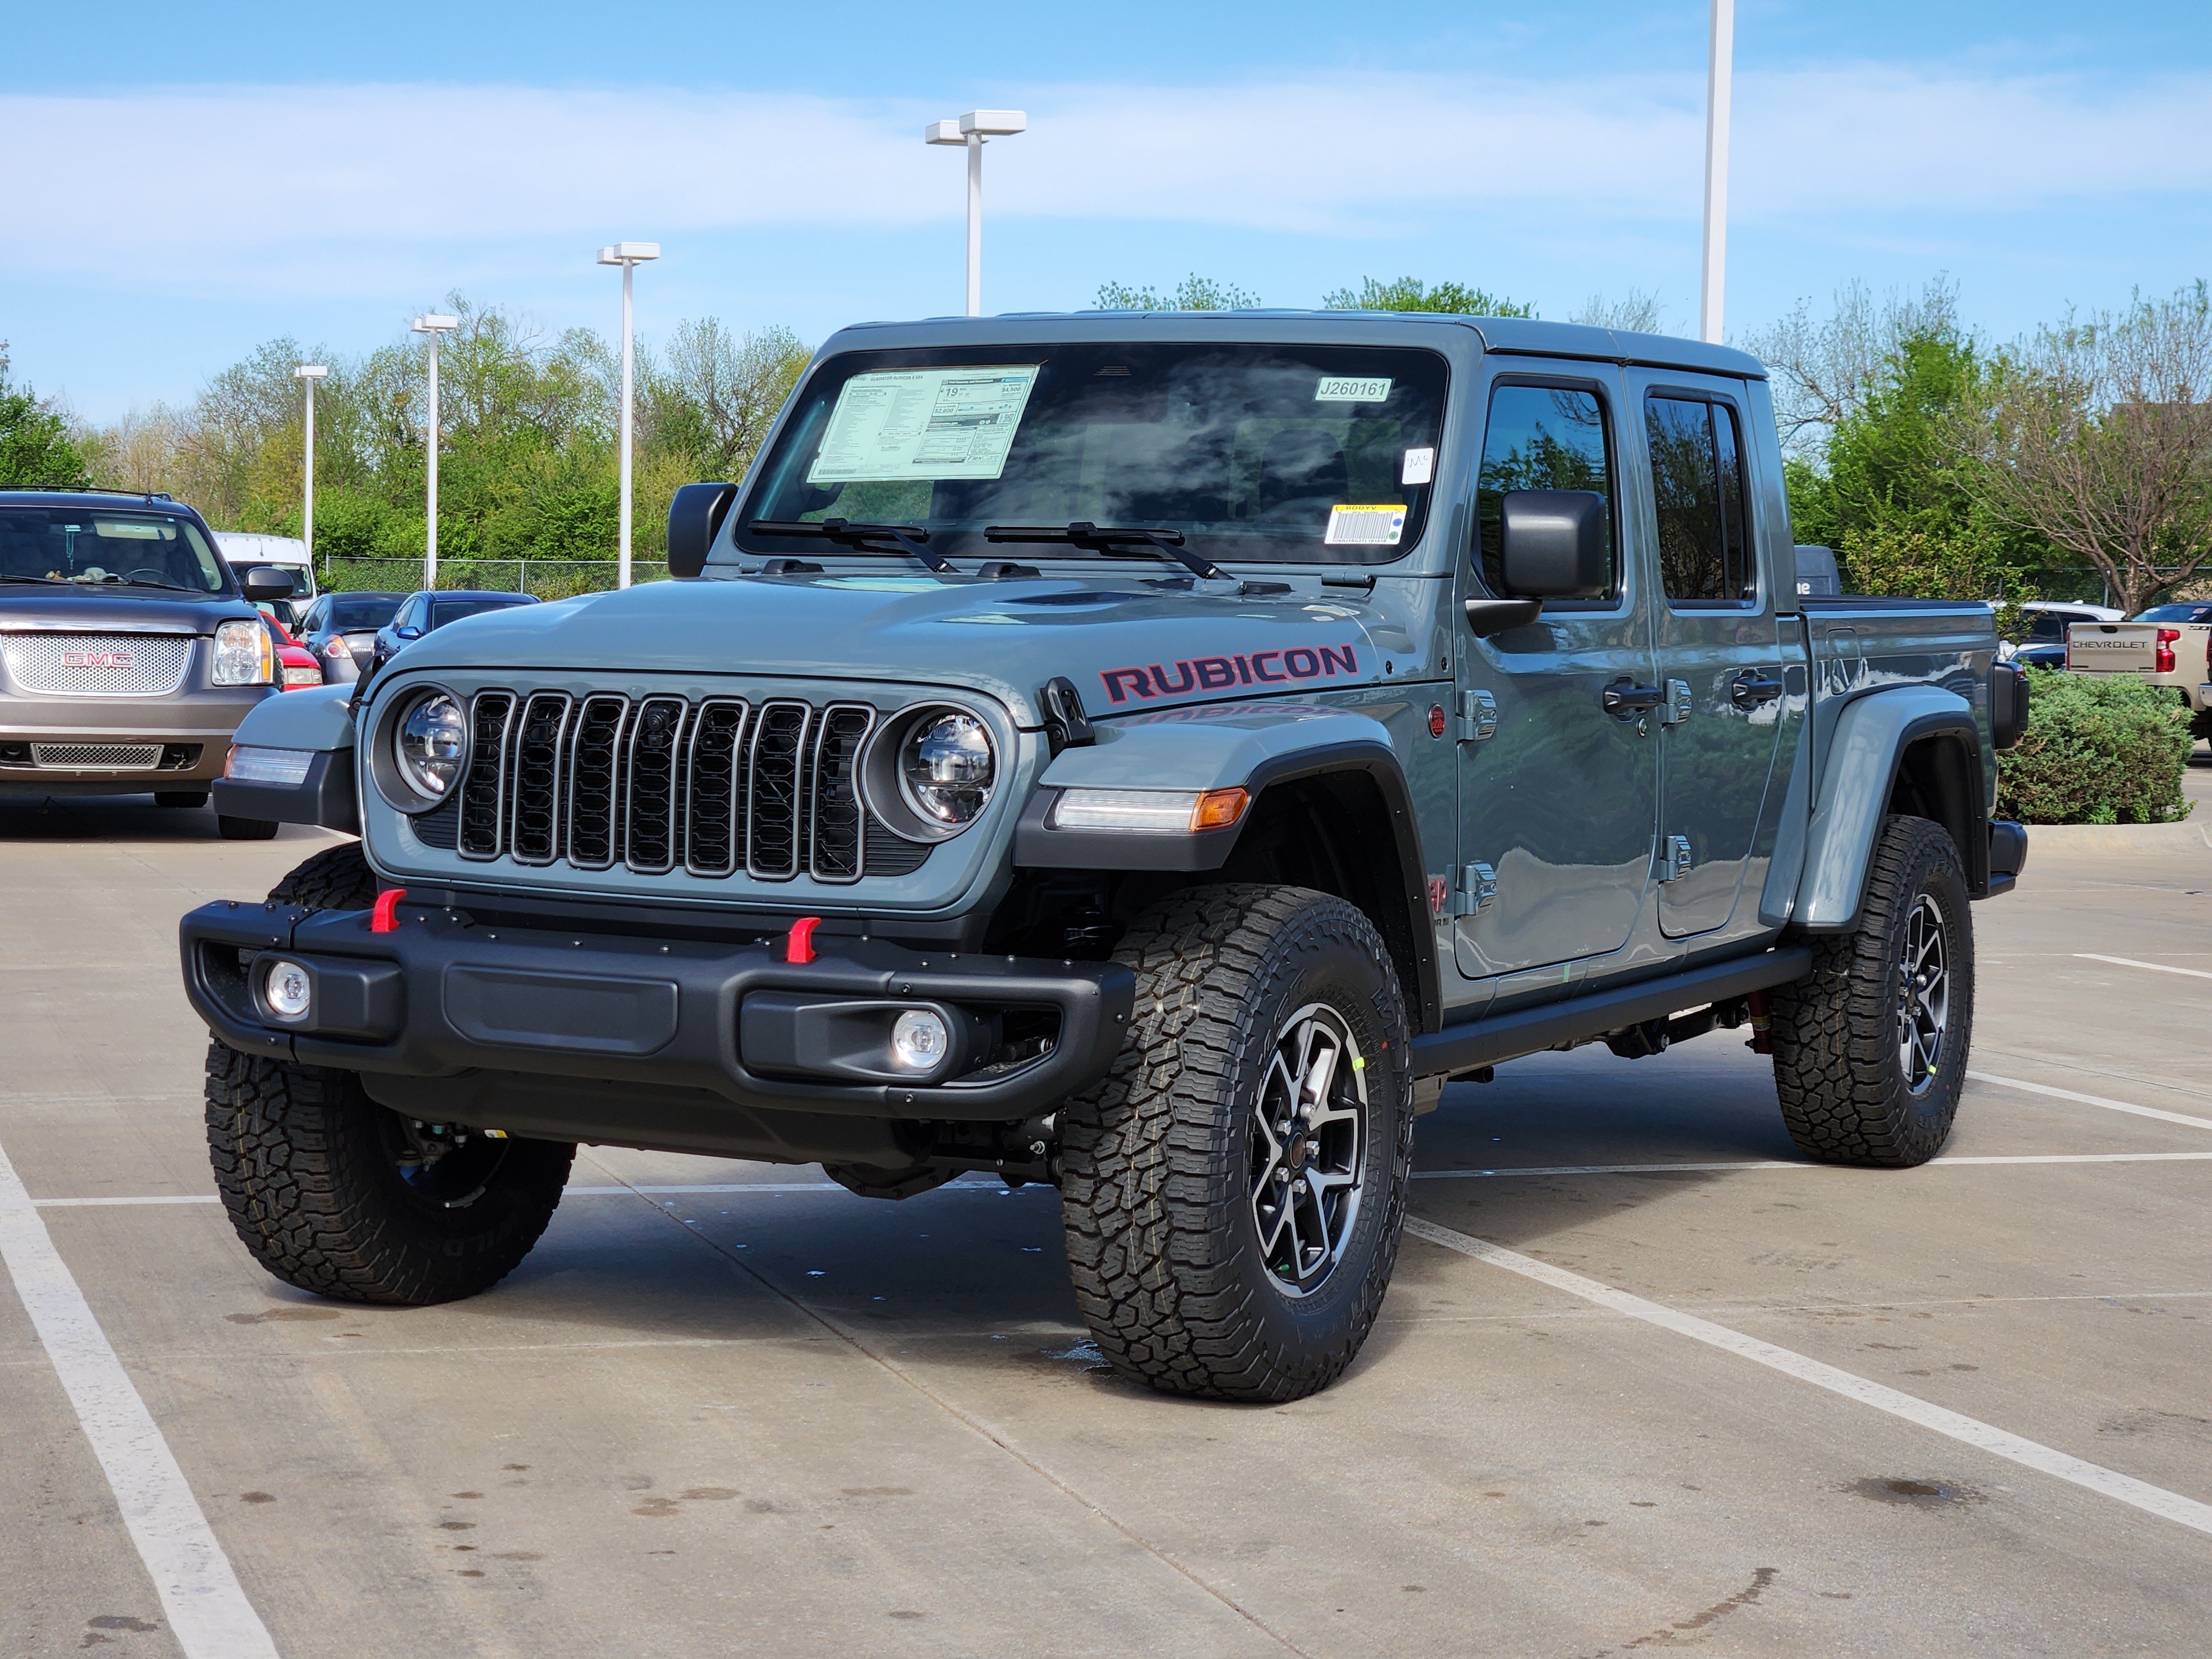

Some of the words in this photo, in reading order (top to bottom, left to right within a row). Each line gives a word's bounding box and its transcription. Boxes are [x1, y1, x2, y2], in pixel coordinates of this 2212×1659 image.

[946, 388, 958, 397] 19
[1321, 382, 1386, 396] J260161
[63, 652, 133, 667] GMC
[1099, 643, 1360, 704] RUBICON
